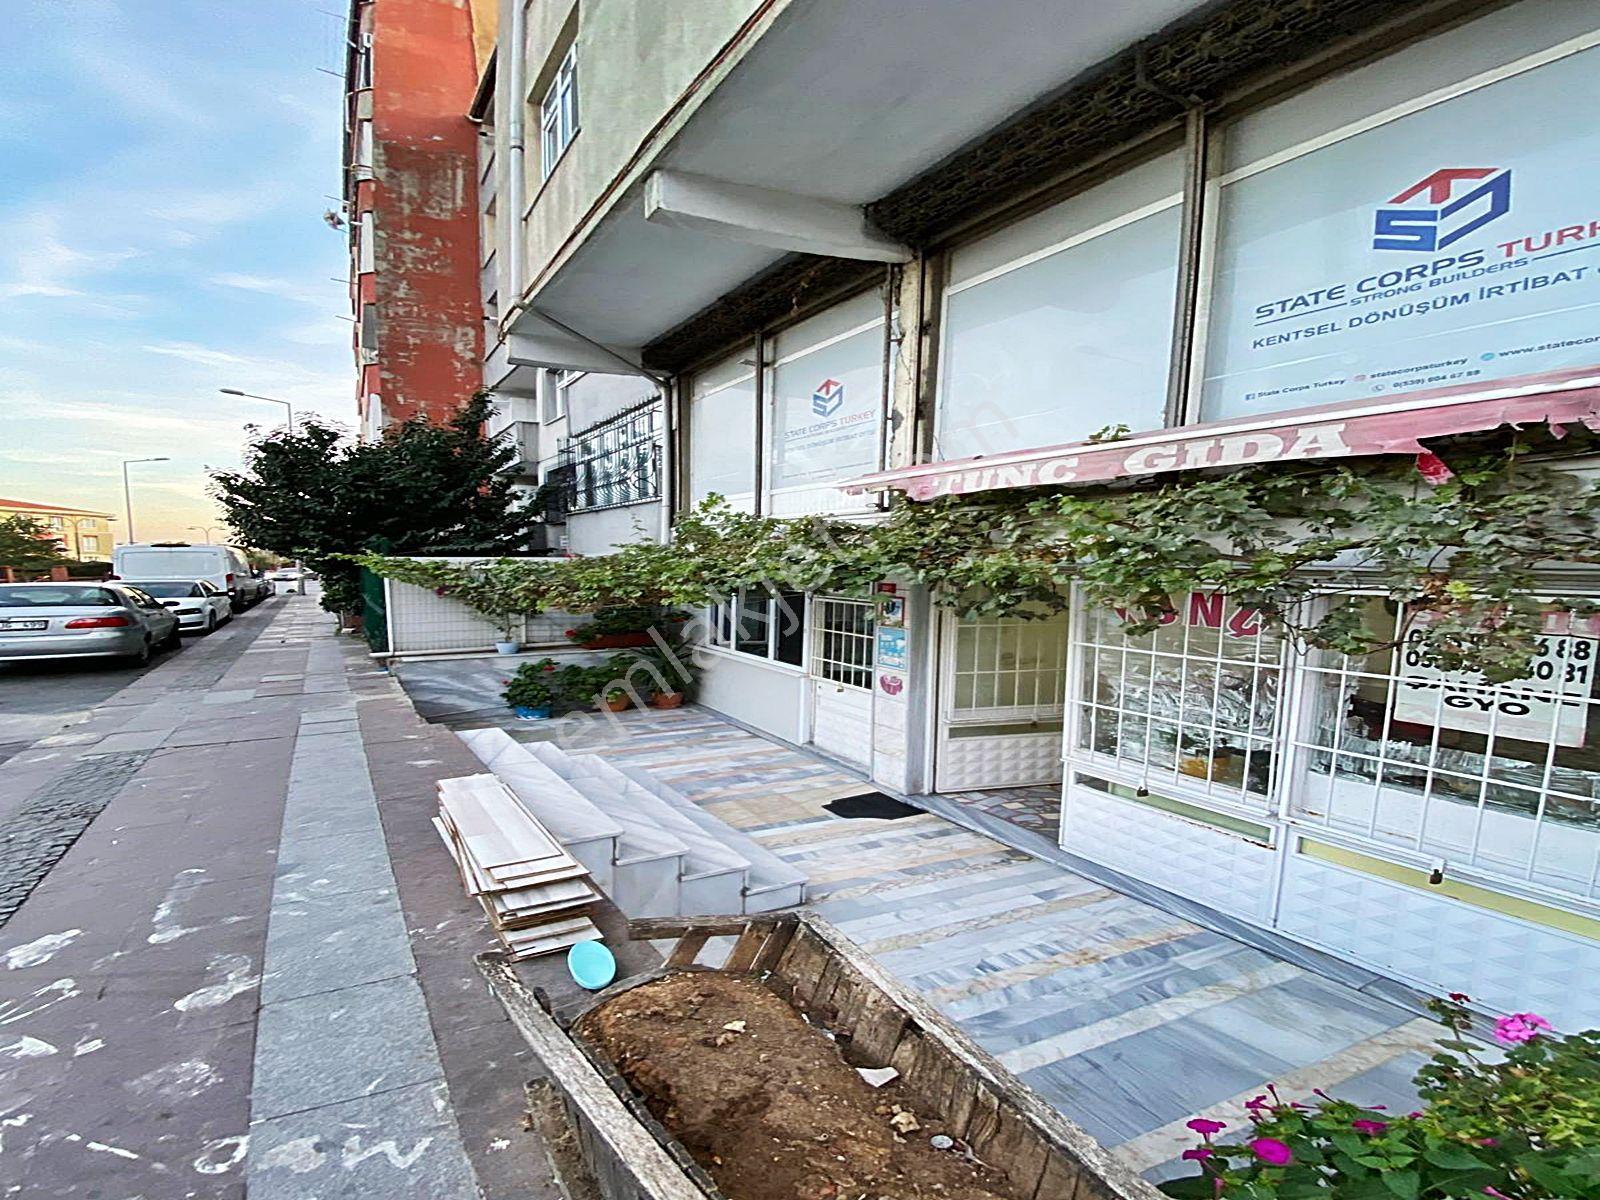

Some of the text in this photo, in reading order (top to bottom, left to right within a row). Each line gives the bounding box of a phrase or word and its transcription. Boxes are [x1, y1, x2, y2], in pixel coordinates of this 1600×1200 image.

[1255, 284, 1346, 320] STATE
[1356, 249, 1485, 295] CORPS
[1350, 257, 1529, 307] STRONG BUILDERS
[1252, 266, 1590, 350] KENTSEL DÖNÜŞÜM İRTİBAT
[1123, 423, 1352, 474] GIDA
[1444, 695, 1530, 716] GYO
